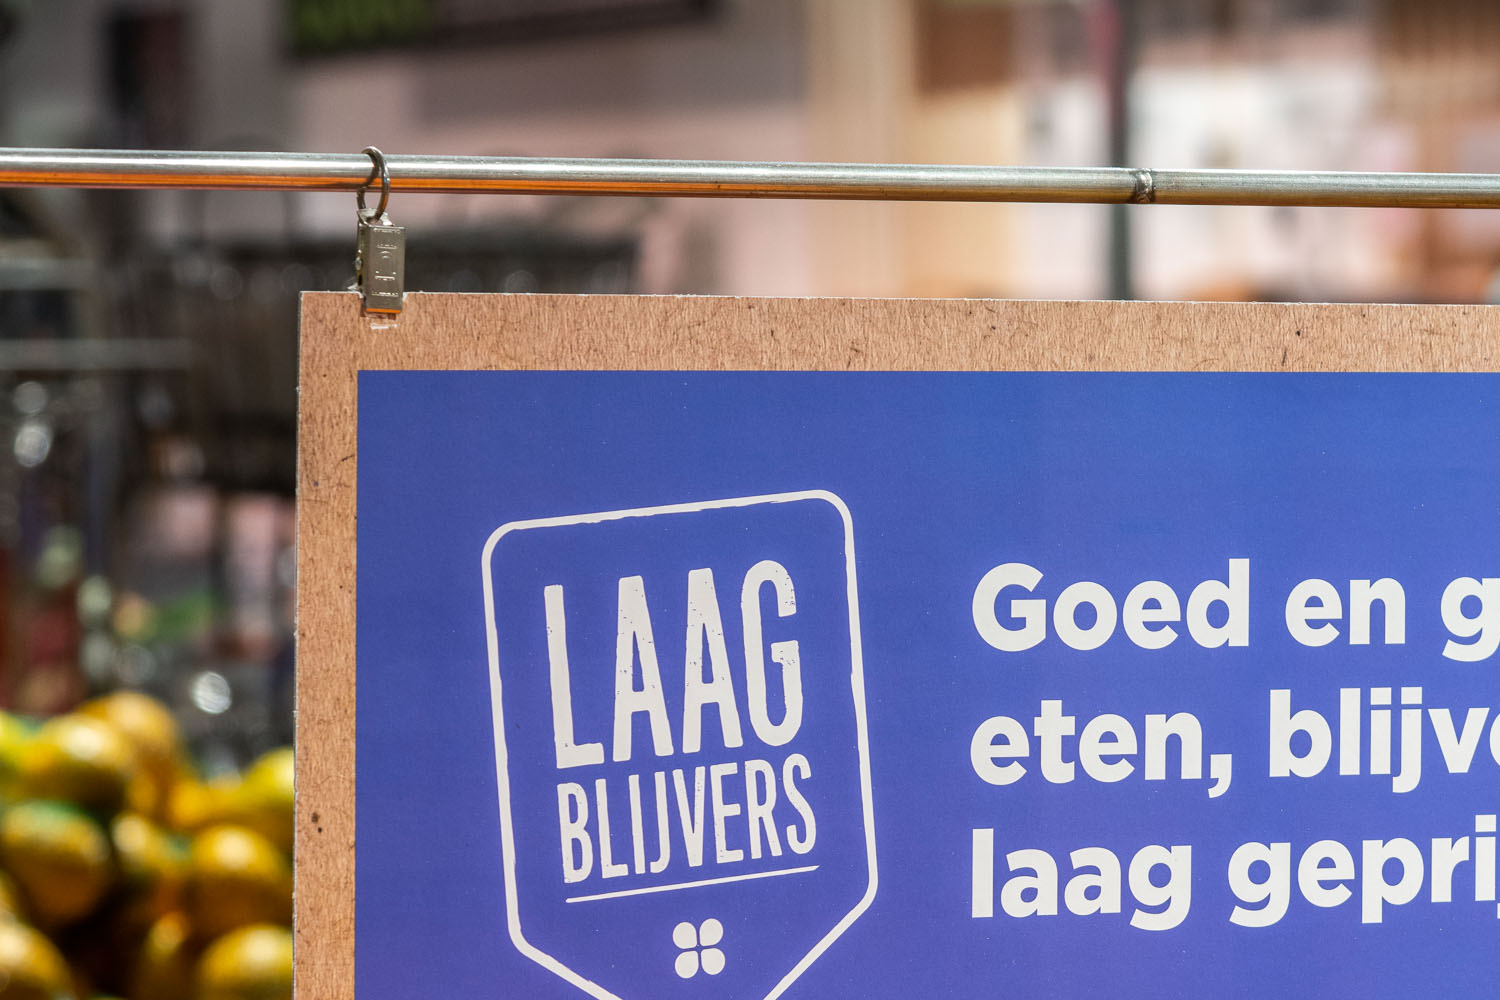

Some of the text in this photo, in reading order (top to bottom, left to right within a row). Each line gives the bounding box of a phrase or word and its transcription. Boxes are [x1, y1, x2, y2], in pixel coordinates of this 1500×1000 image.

[971, 557, 1250, 653] Goed
[1284, 577, 1406, 648] en
[543, 559, 804, 770] LAAG
[970, 699, 1233, 799] eten,
[556, 753, 817, 884] BLIJVERS
[971, 827, 1193, 932] laag
